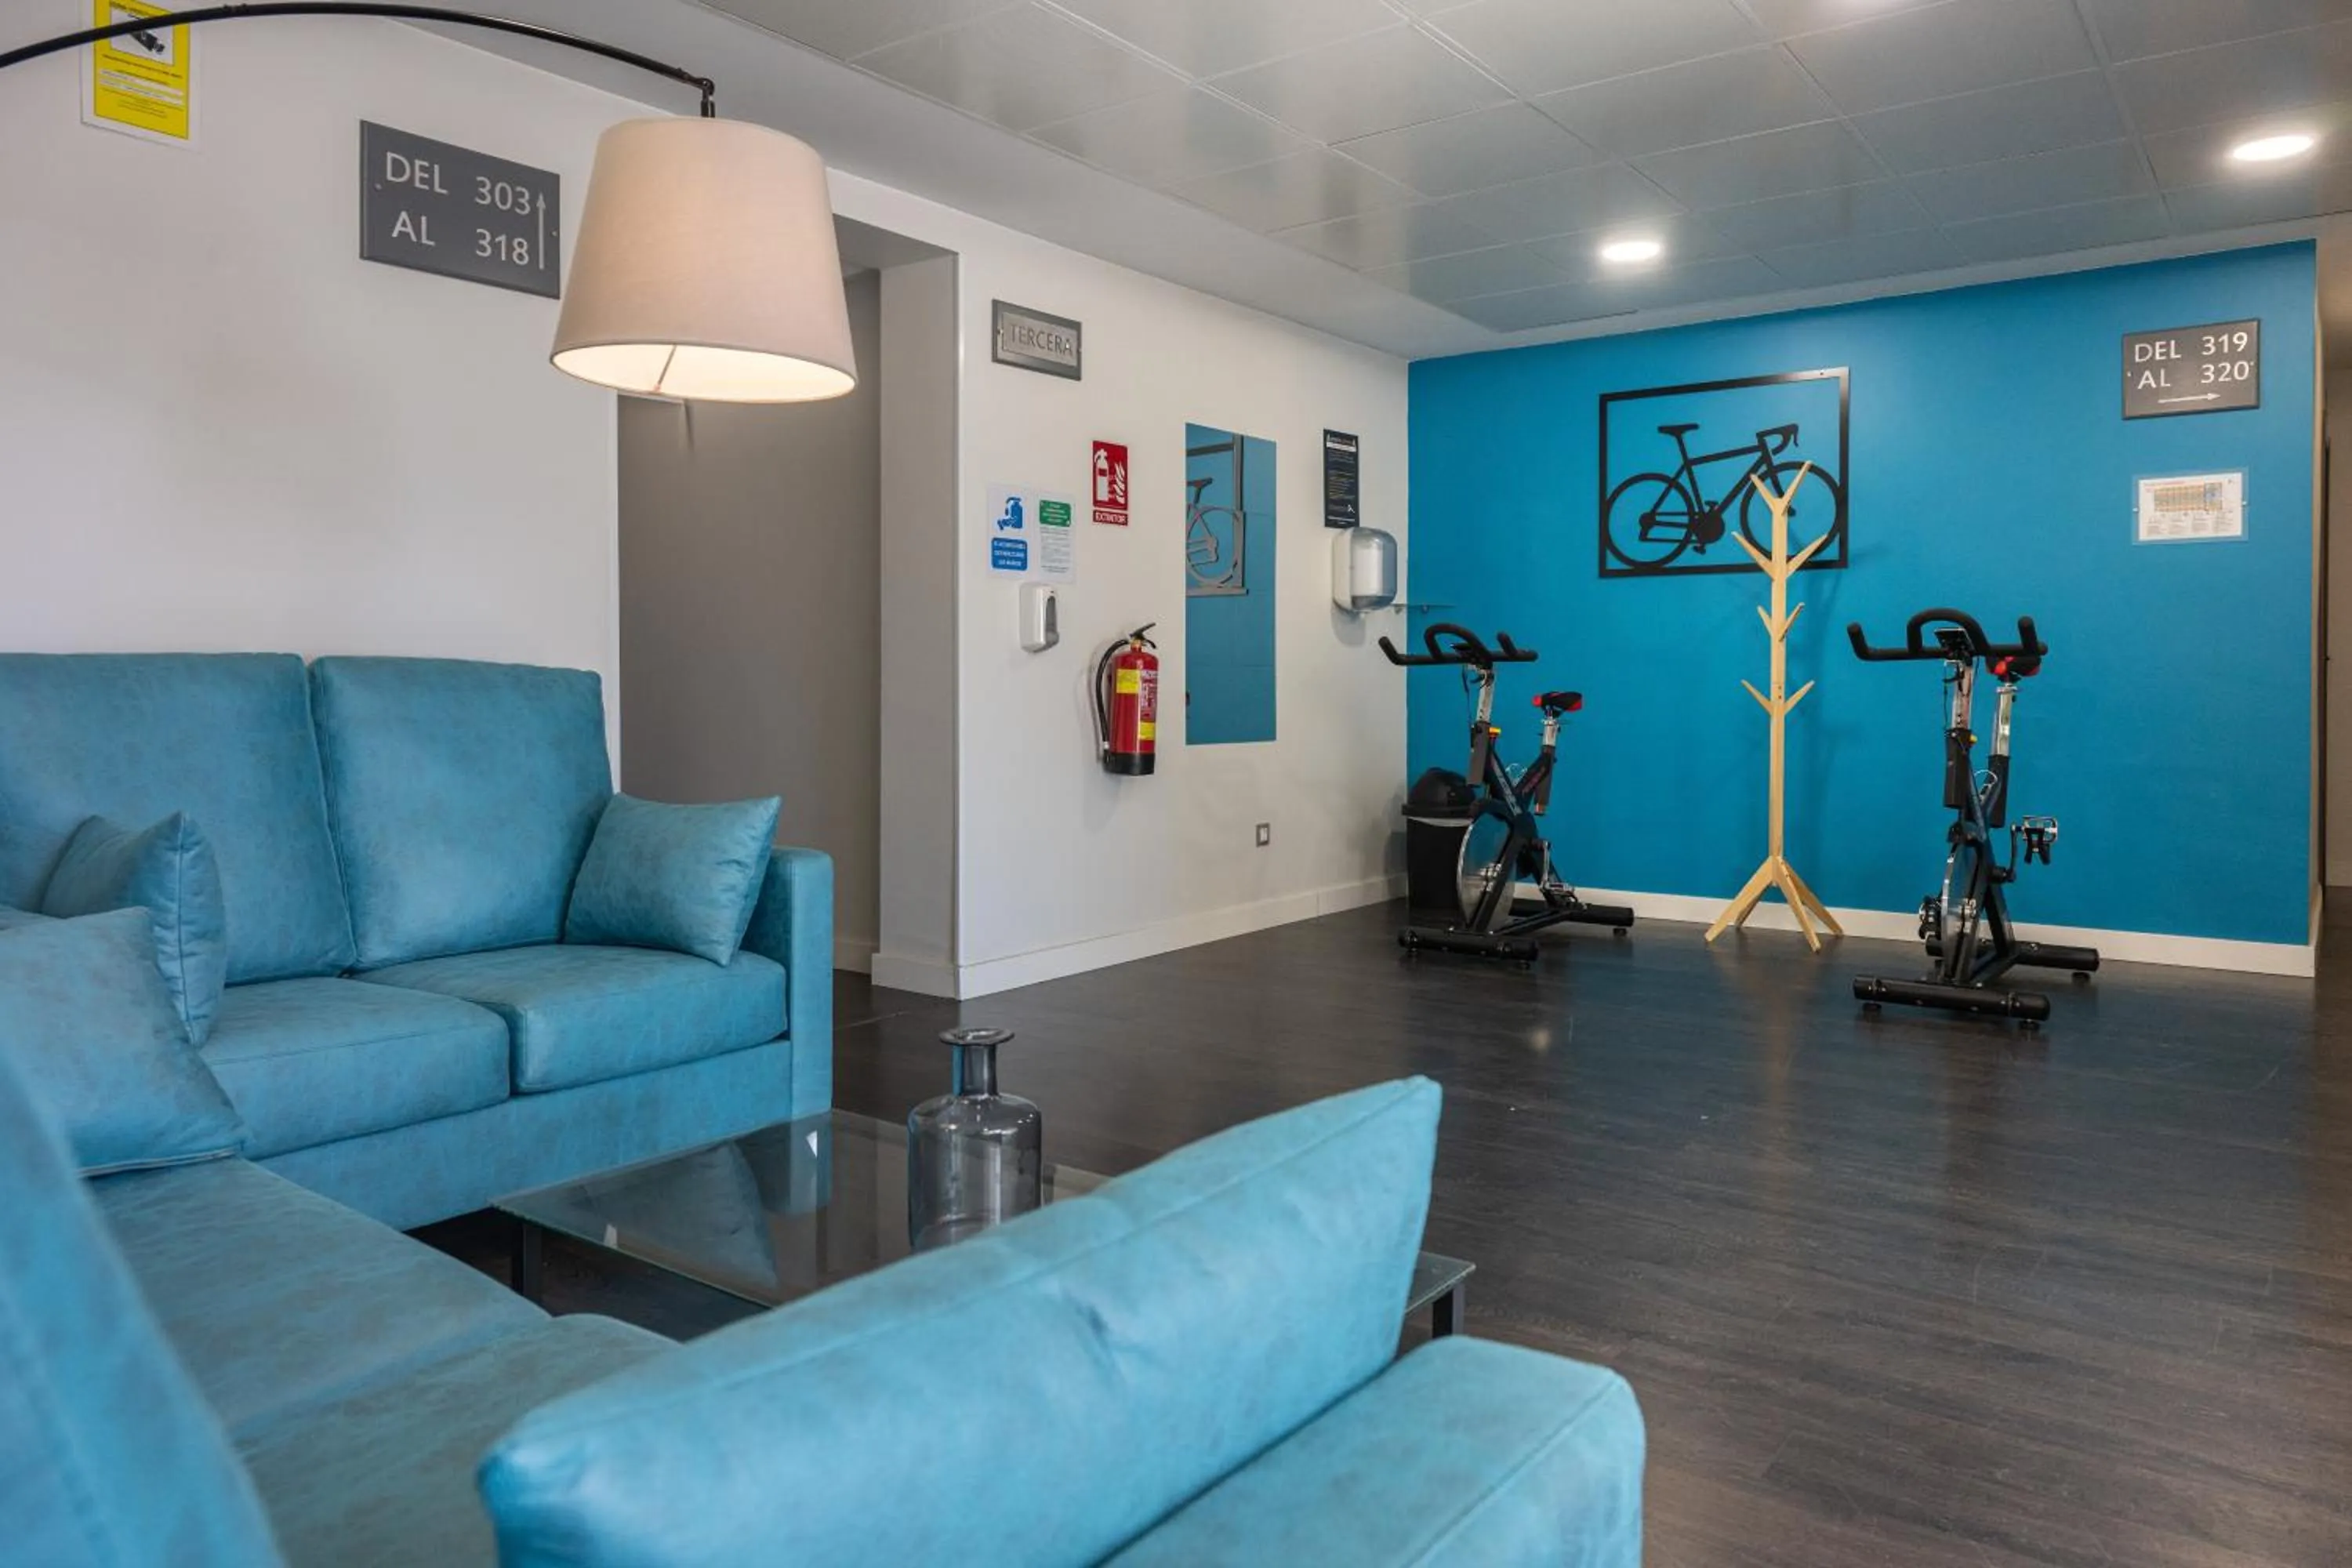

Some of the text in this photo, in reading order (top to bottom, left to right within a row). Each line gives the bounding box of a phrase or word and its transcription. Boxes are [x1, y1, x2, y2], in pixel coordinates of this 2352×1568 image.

[386, 151, 531, 215] DEL 303
[391, 210, 529, 265] AL 318
[1010, 322, 1073, 357] TERCERA
[2134, 332, 2248, 363] DEL 319
[2137, 361, 2249, 389] AL 320
